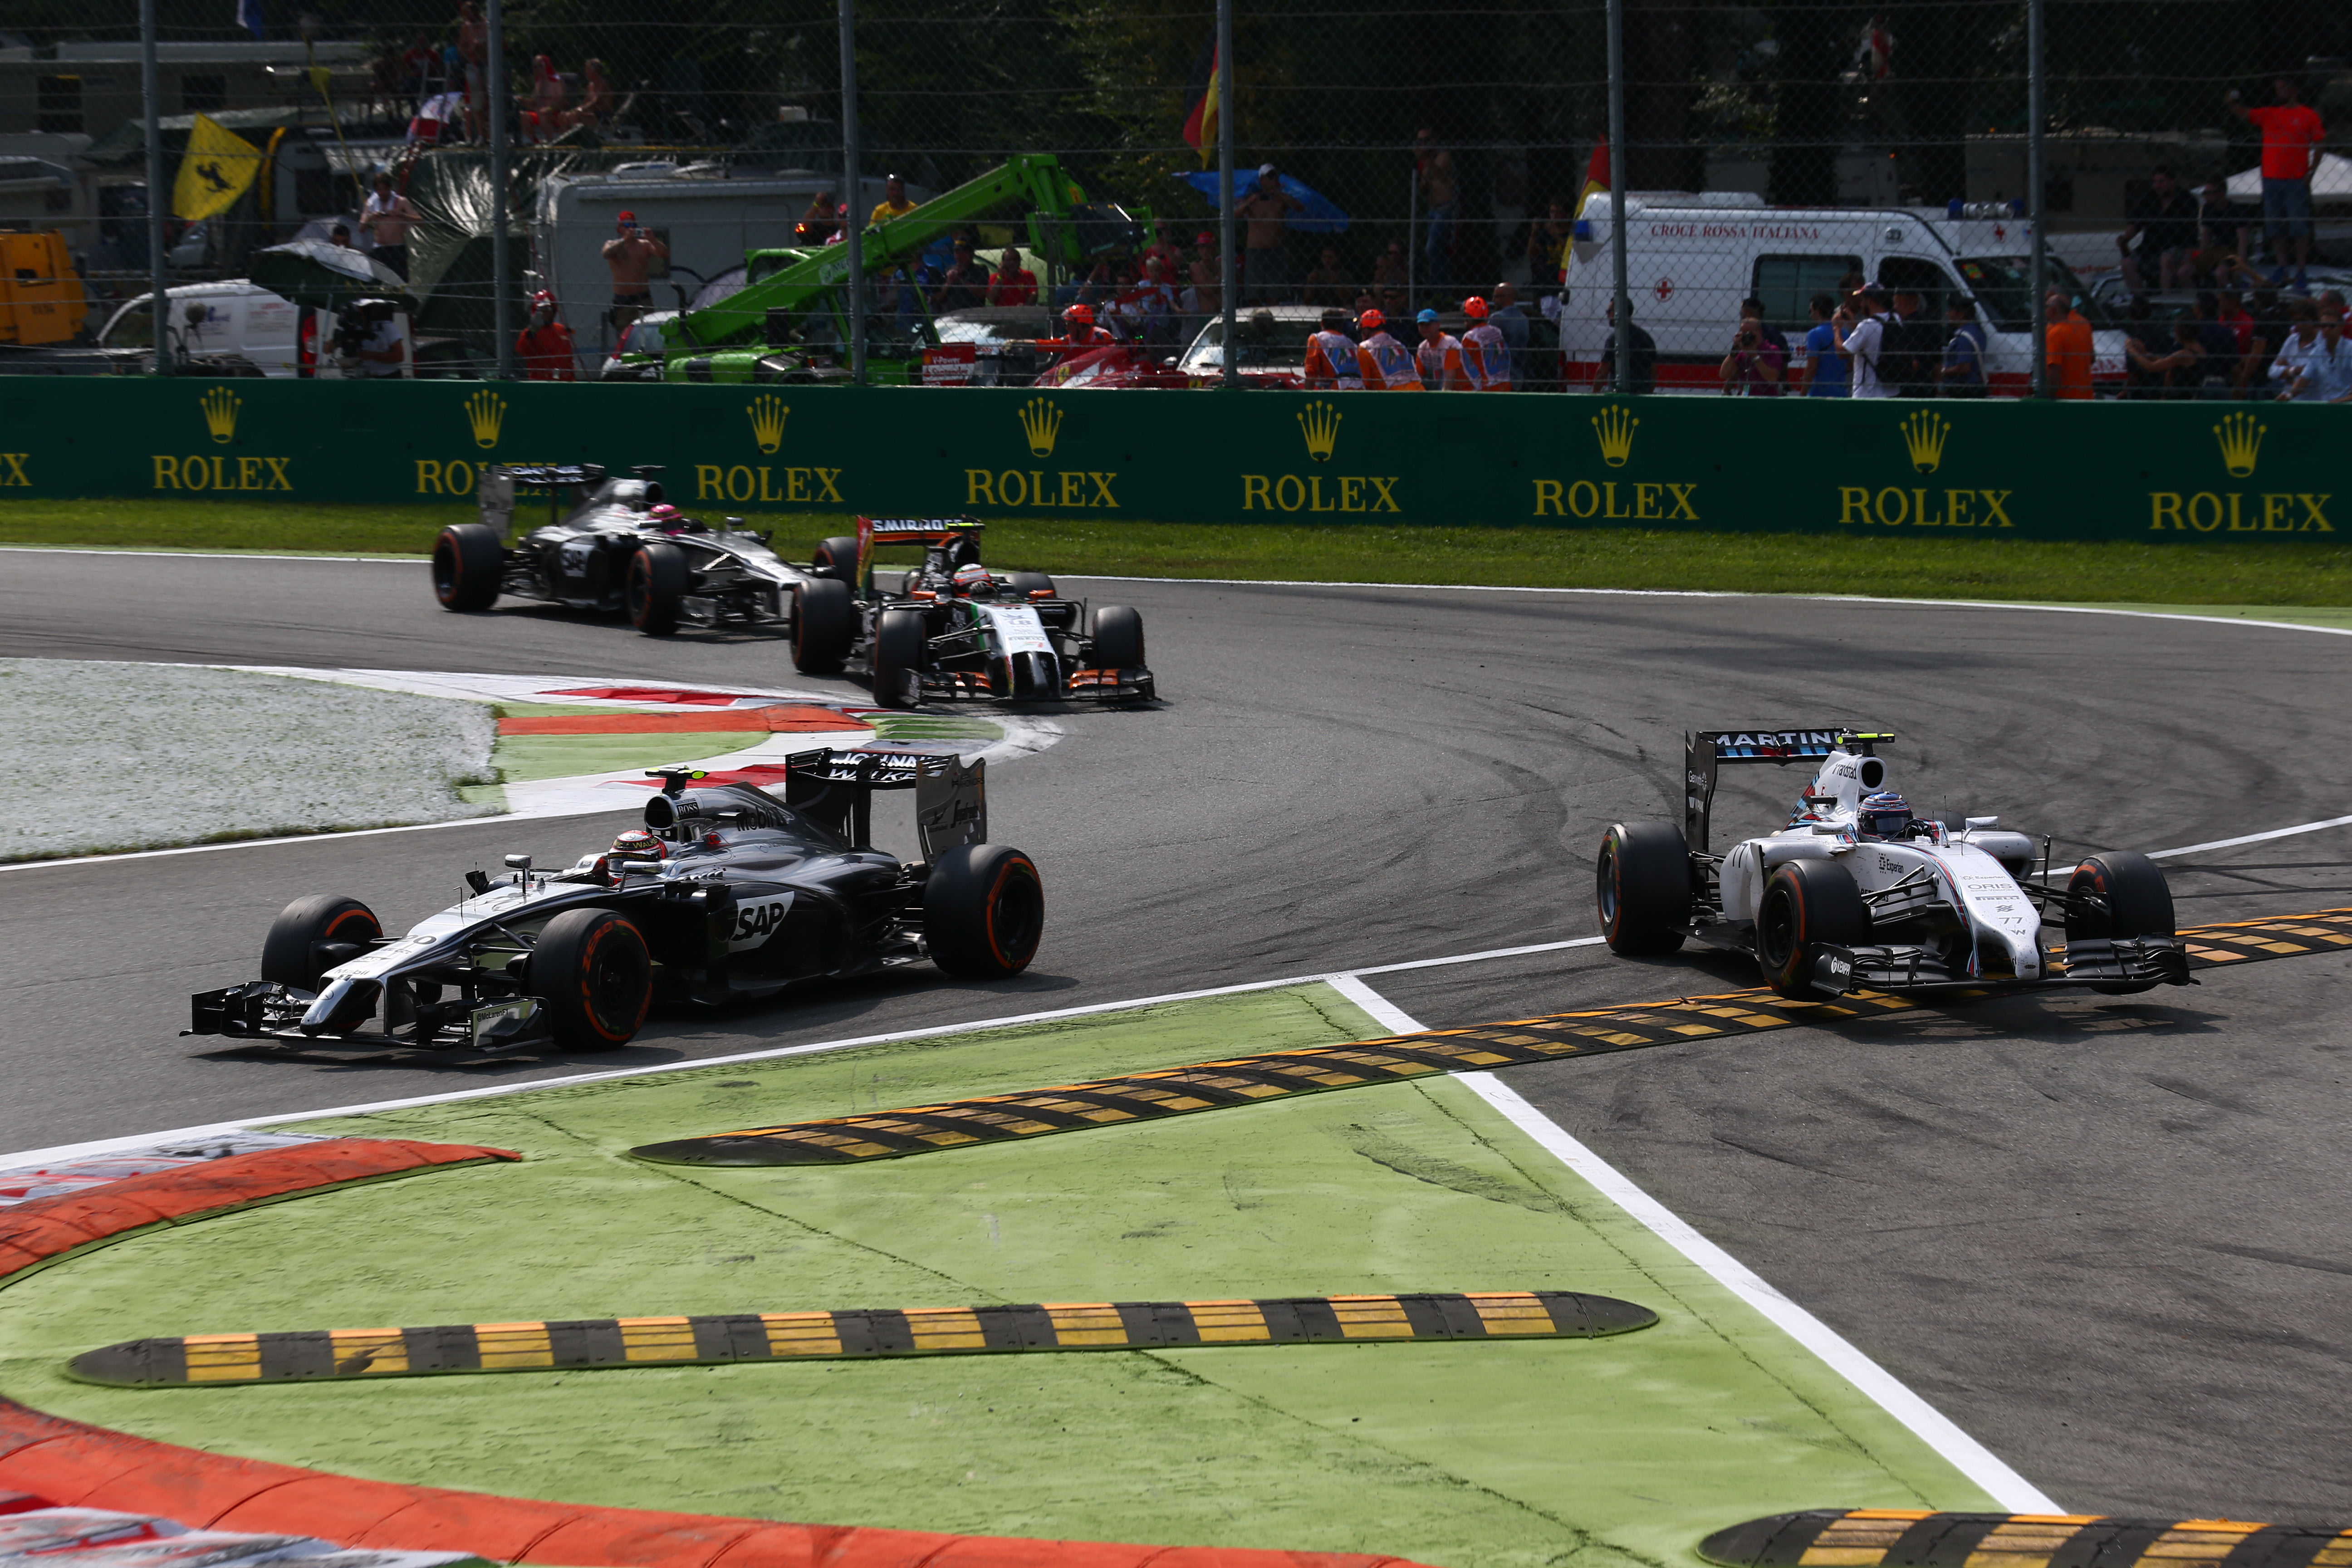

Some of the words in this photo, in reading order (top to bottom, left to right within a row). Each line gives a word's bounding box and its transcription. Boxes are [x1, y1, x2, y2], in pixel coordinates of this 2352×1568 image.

[1651, 223, 1698, 238] CROCE
[1702, 225, 1746, 238] ROSSA
[1752, 225, 1819, 239] ITALIANA
[932, 355, 960, 364] V-Power
[932, 366, 968, 375] Santander
[152, 455, 294, 490] ROLEX
[695, 465, 845, 502] ROLEX
[965, 468, 1120, 507] ROLEX
[1241, 474, 1402, 512] ROLEX
[1533, 480, 1700, 519] ROLEX
[1838, 486, 2016, 528] ROLEX
[2148, 491, 2336, 532] ROLEX
[1715, 731, 1841, 747] MARTINI
[678, 804, 698, 815] BOSS
[735, 806, 774, 832] Mobil
[1732, 843, 1749, 868] 77
[1886, 858, 1904, 874] Experian
[729, 902, 785, 942] SAP
[403, 934, 437, 945] 20
[1837, 960, 1851, 976] KEMPPI
[477, 1008, 509, 1022] @McLarenF1
